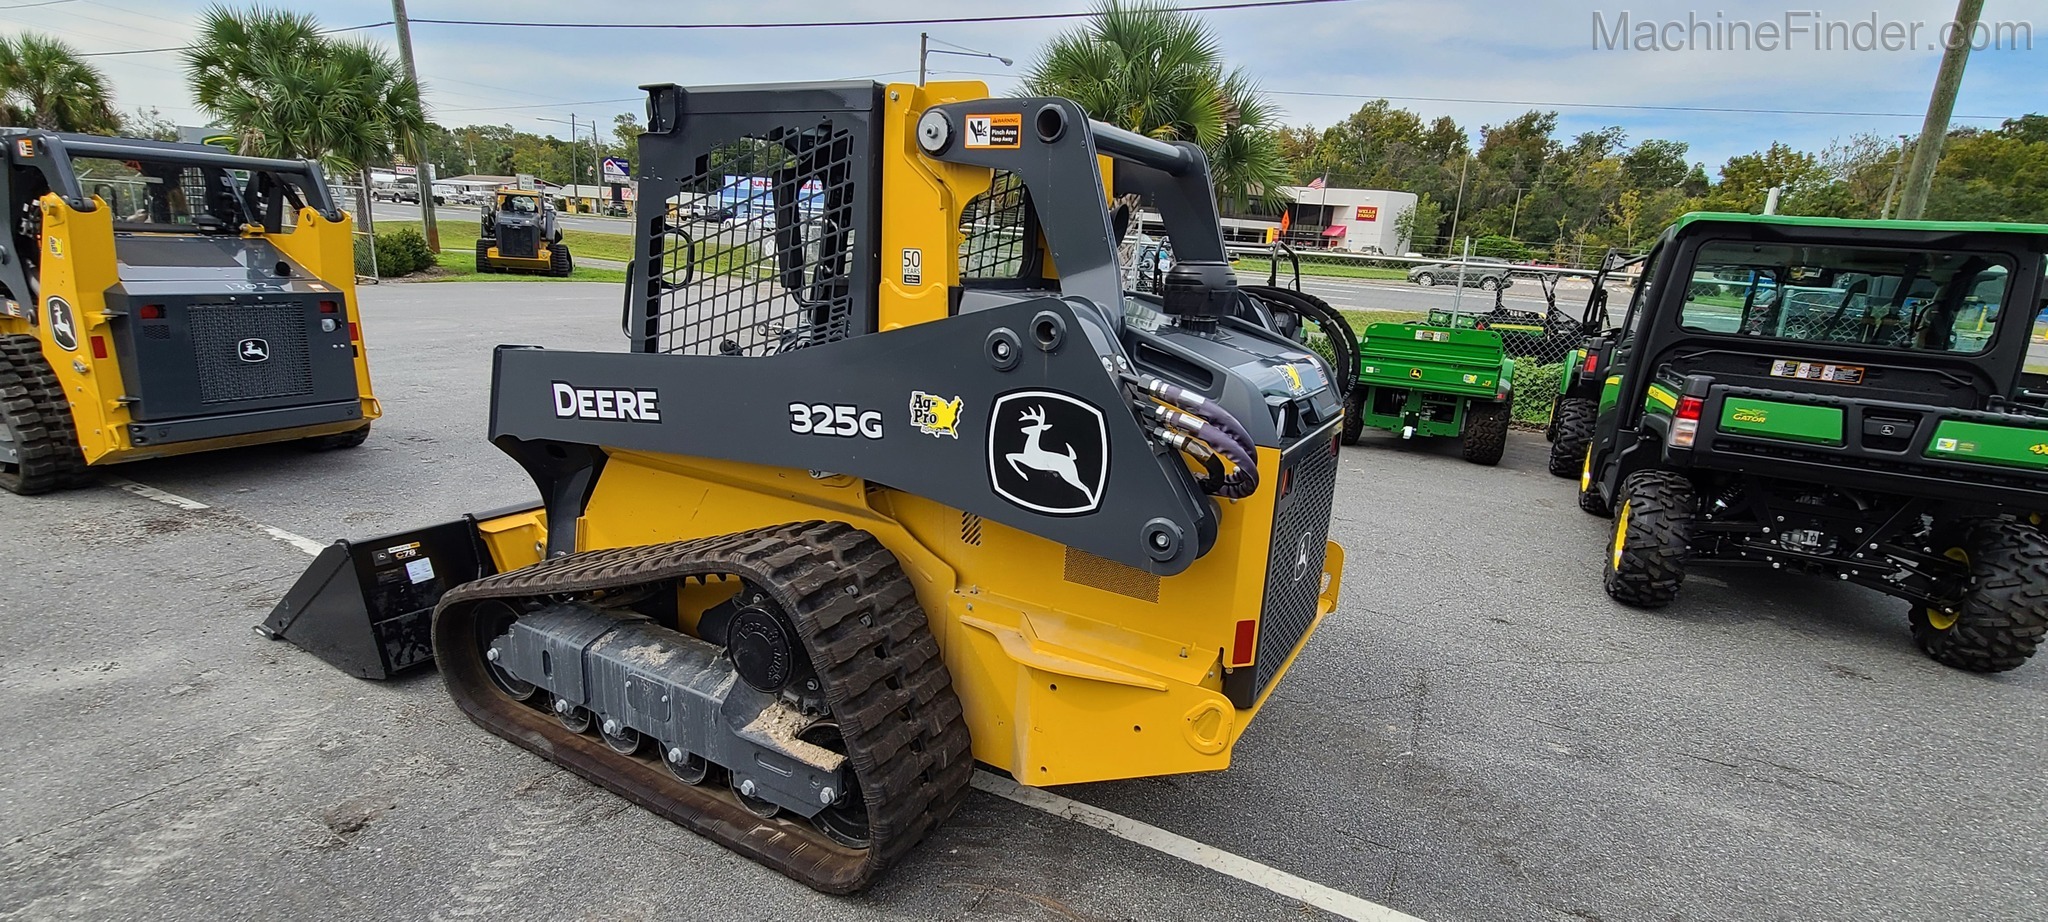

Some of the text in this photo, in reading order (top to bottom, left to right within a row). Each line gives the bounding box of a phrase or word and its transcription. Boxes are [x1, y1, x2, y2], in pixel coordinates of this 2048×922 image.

[904, 250, 920, 268] 50
[552, 383, 660, 421] DEERE
[913, 394, 937, 412] Ag-
[789, 403, 883, 439] 325G
[913, 409, 937, 424] Pro
[1732, 413, 1766, 423] GATOR
[395, 549, 417, 560] C78
